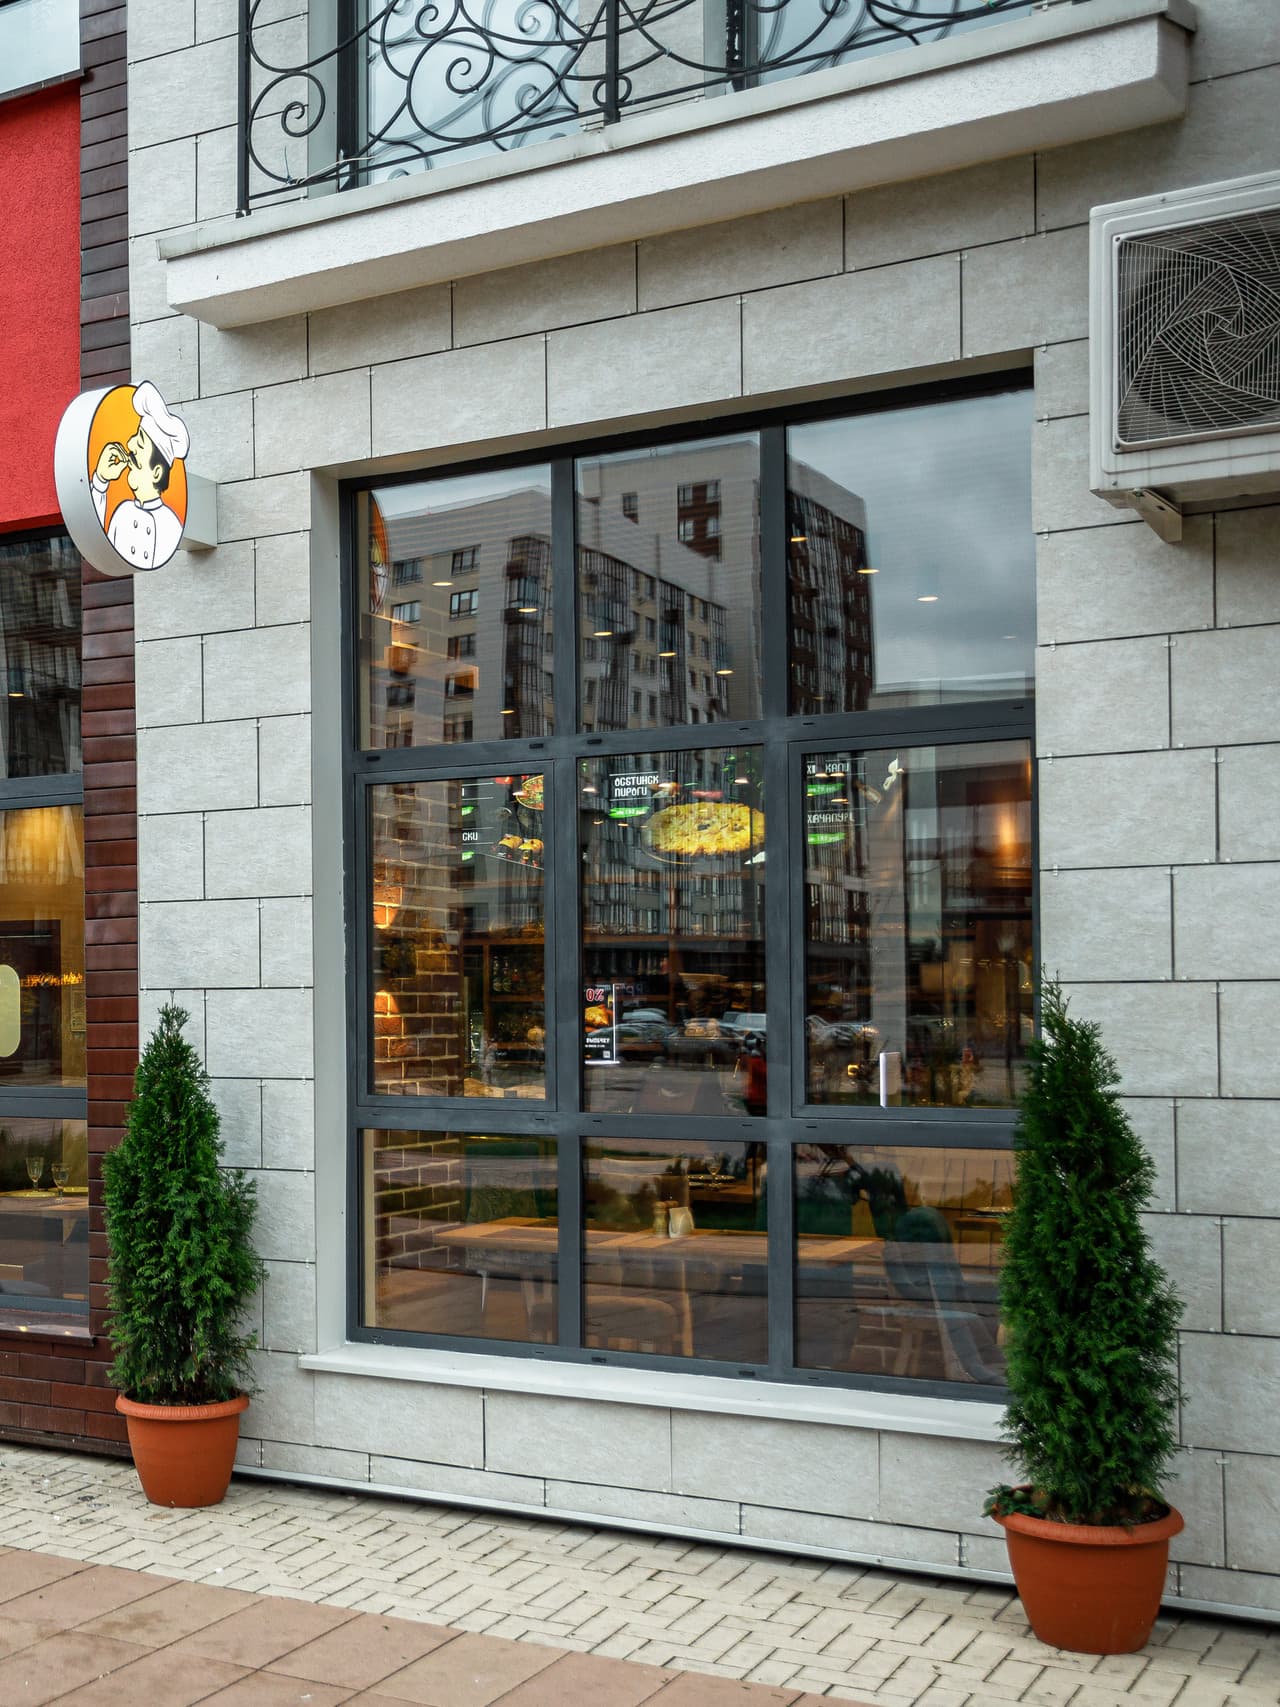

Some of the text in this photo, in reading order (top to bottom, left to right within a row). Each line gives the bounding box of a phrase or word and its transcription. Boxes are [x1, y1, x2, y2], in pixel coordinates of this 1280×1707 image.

[614, 775, 659, 787] ОСЕТИНСК
[462, 831, 478, 842] СКИ
[586, 988, 605, 1002] 0%
